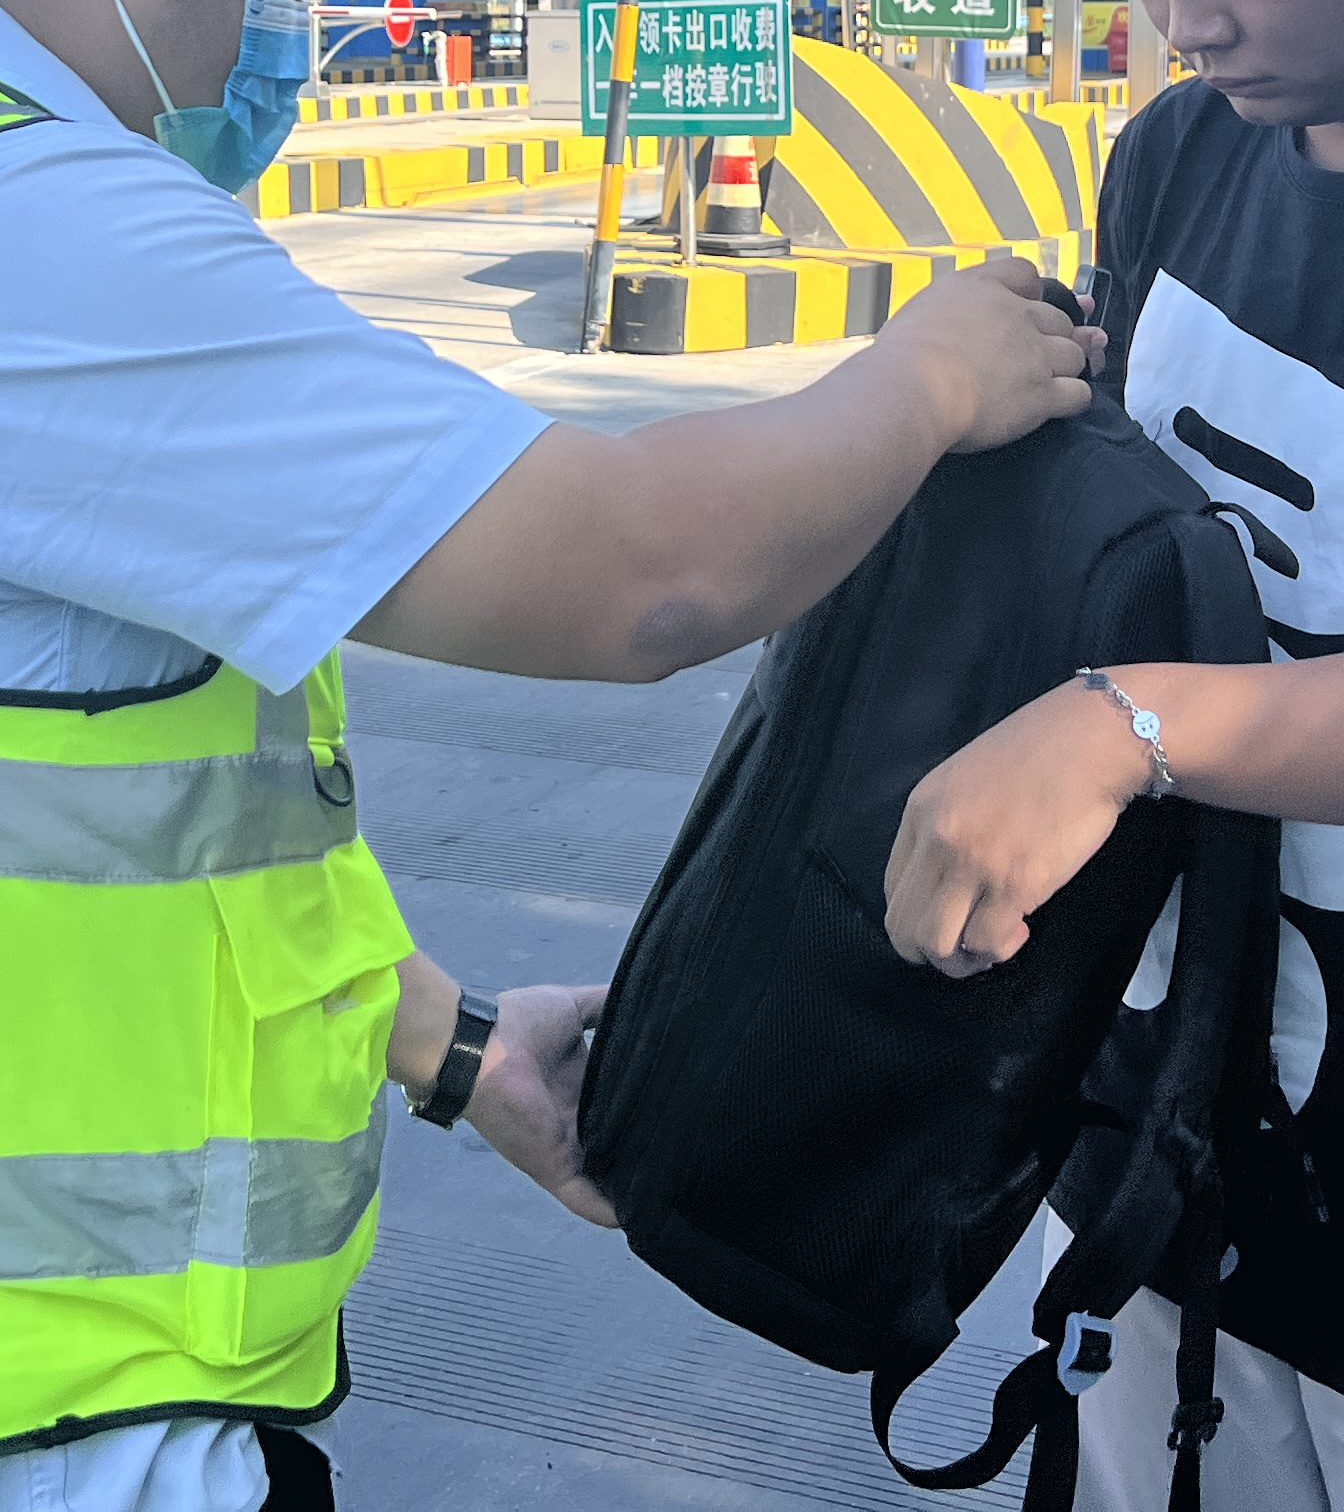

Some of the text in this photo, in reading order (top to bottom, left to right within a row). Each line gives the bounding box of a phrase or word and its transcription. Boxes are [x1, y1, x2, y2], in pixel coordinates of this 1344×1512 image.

[595, 7, 776, 54] 入领卡出口收费
